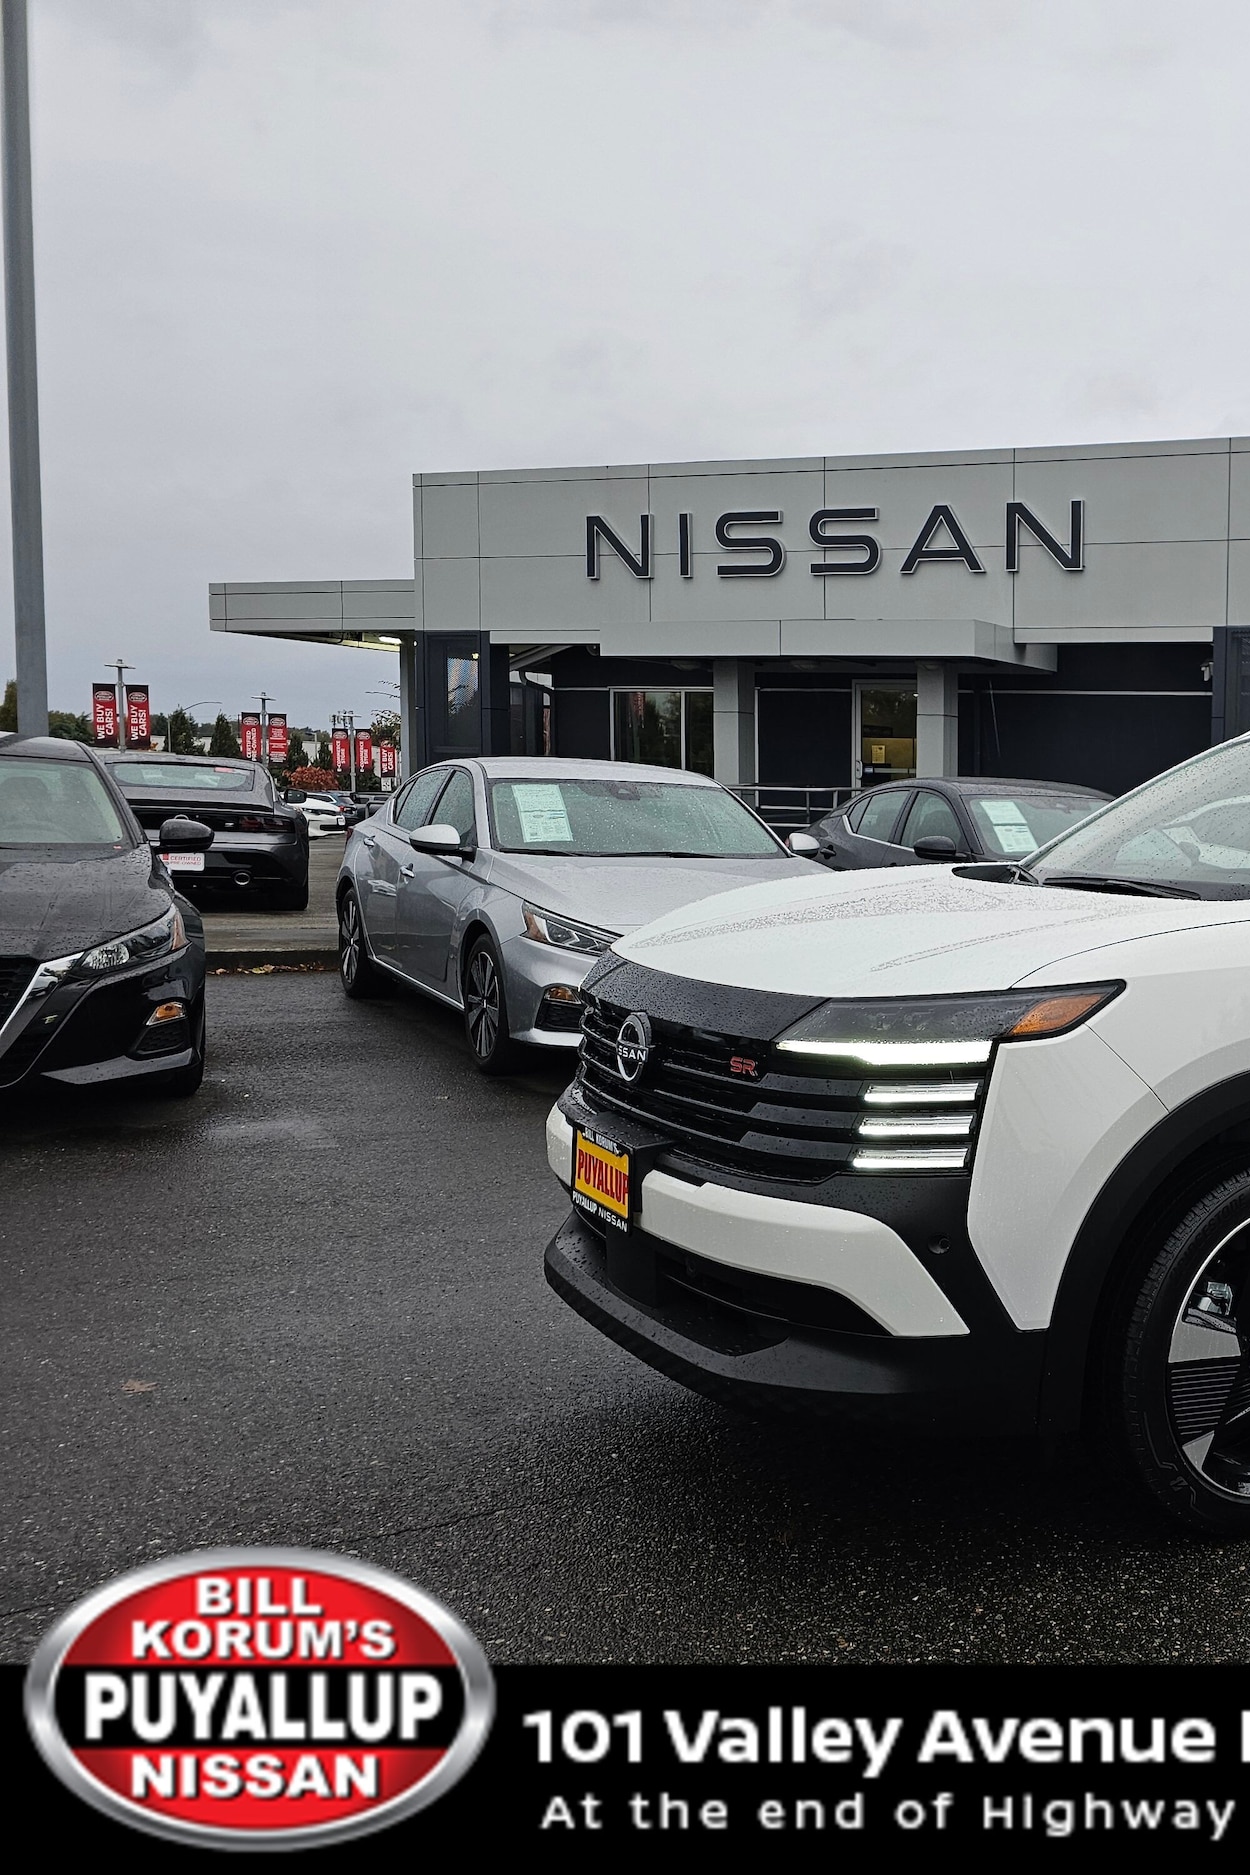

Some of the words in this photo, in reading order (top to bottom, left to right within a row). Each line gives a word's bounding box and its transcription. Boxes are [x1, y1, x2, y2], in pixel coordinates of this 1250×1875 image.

[586, 499, 1085, 580] NISSAN
[96, 703, 105, 723] BUY
[105, 708, 114, 736] CARS!
[130, 704, 139, 724] BUY
[138, 709, 147, 737] CARS!
[96, 725, 105, 740] WE
[130, 725, 139, 741] WE
[617, 1045, 647, 1062] SSAN
[730, 1056, 758, 1076] SR
[577, 1148, 629, 1206] PUYALLUP
[598, 1207, 628, 1232] NISSAN
